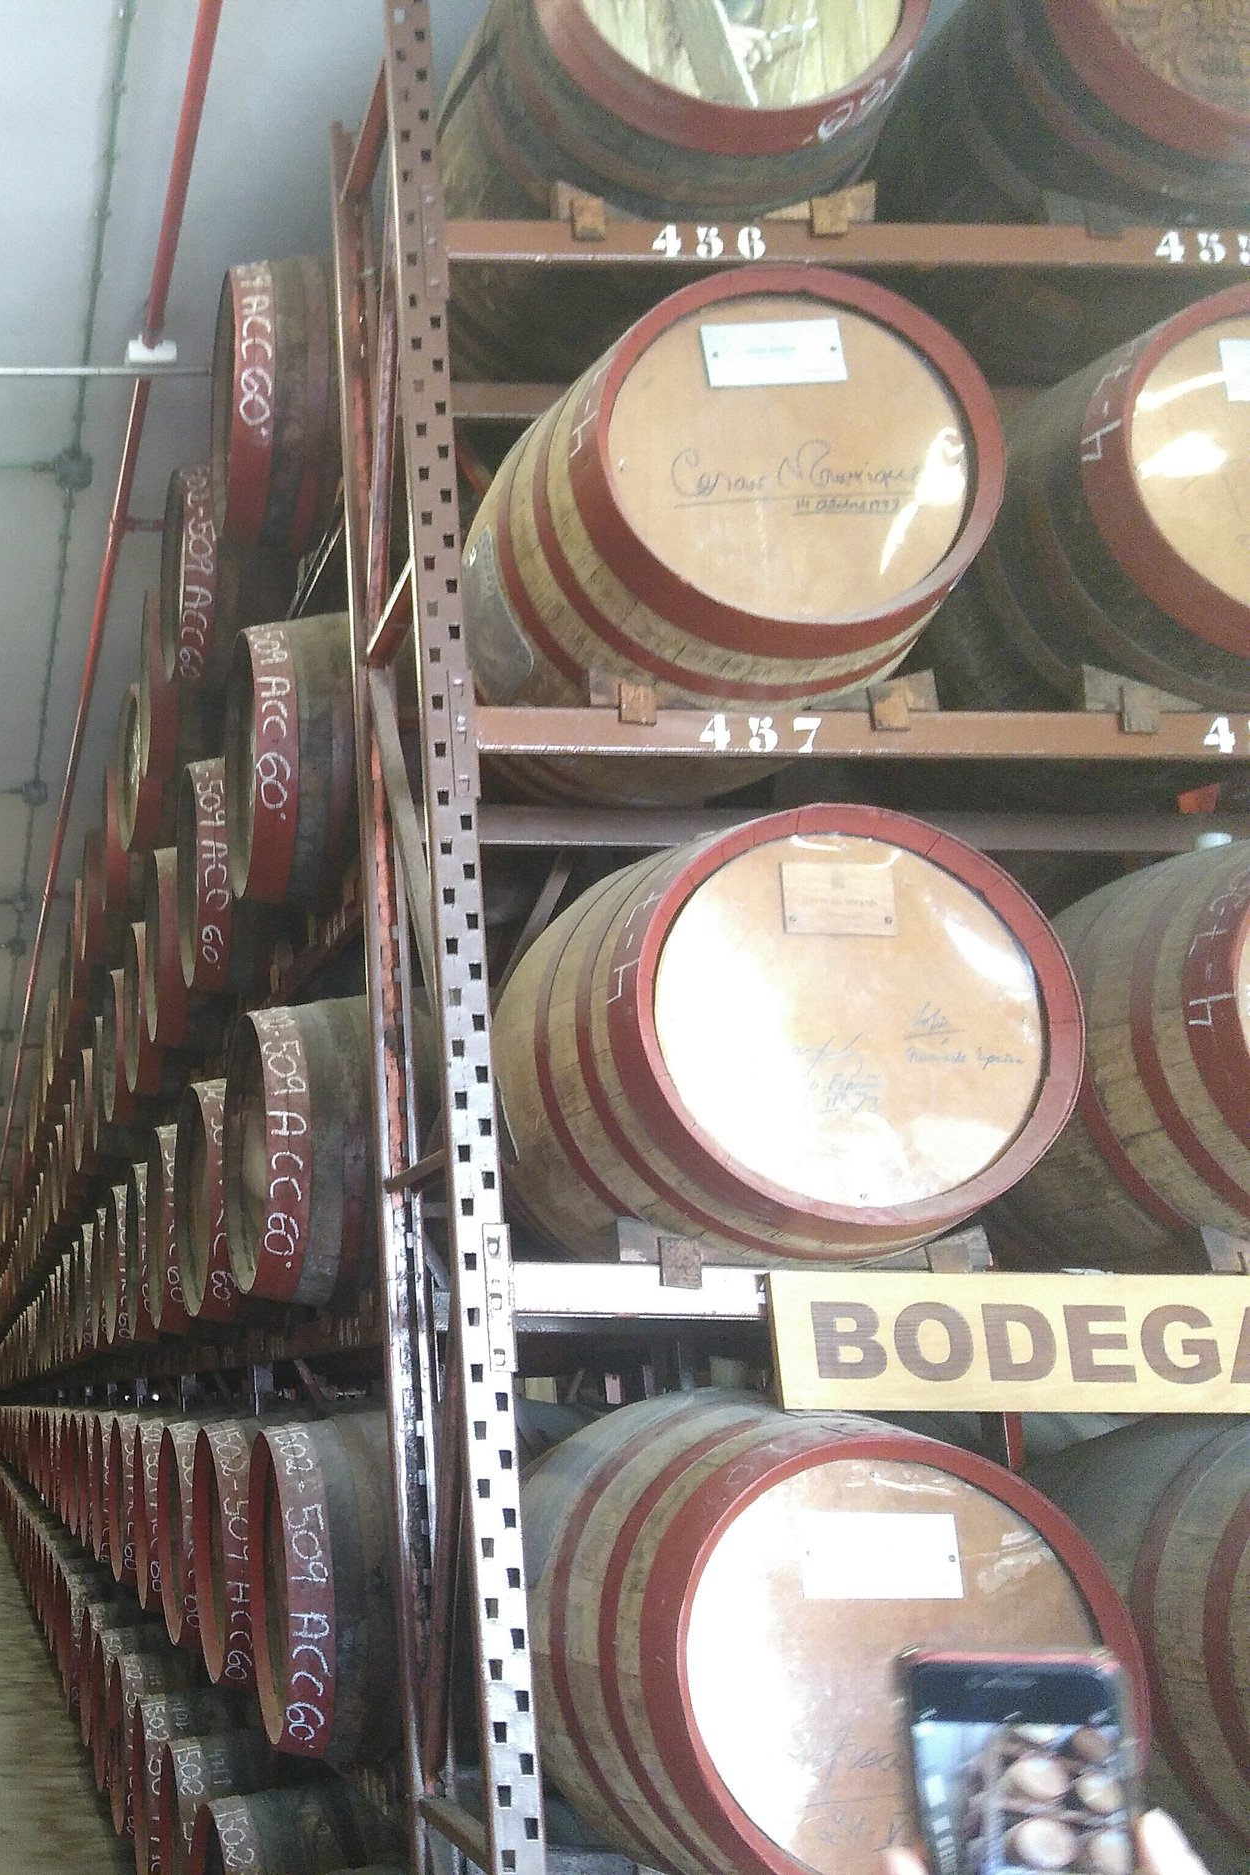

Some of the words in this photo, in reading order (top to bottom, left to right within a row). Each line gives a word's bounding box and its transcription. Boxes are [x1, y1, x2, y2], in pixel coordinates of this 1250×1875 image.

[652, 224, 767, 260] 456
[699, 713, 822, 754] 457
[1203, 716, 1250, 754] 4
[809, 1300, 1250, 1385] BODEG
